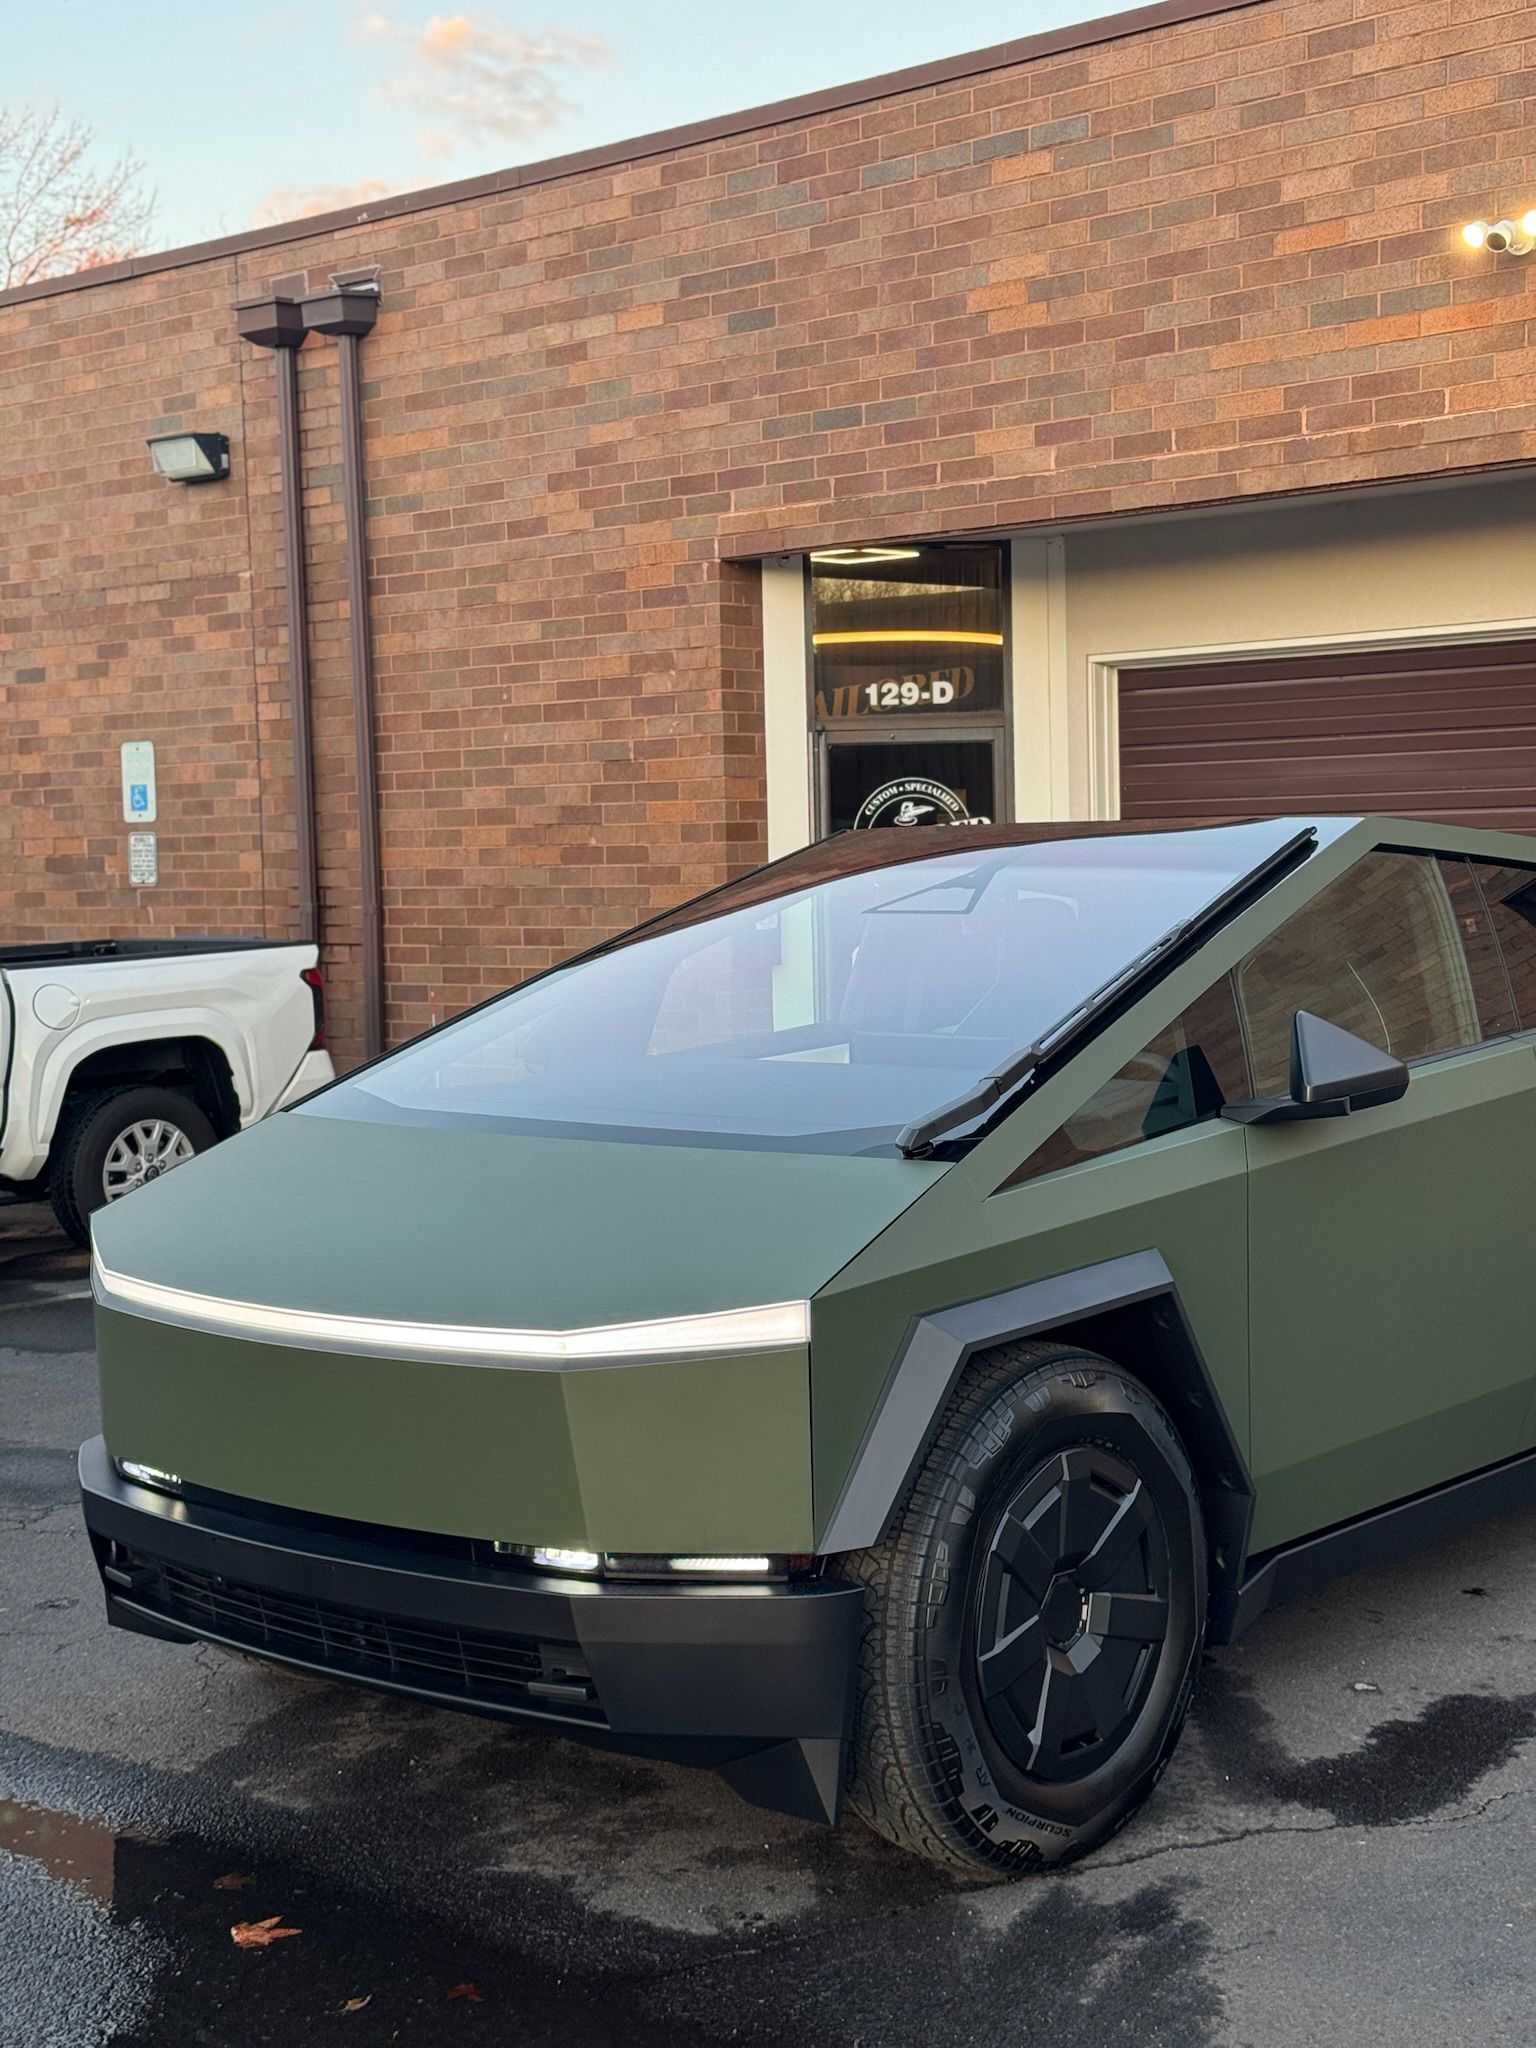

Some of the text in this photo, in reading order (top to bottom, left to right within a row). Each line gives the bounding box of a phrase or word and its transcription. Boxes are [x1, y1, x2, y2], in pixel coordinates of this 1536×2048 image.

[865, 681, 954, 706] 129-D
[864, 782, 960, 816] CUSTOM SPECIALIZED
[1004, 1806, 1073, 1838] SCORPION
